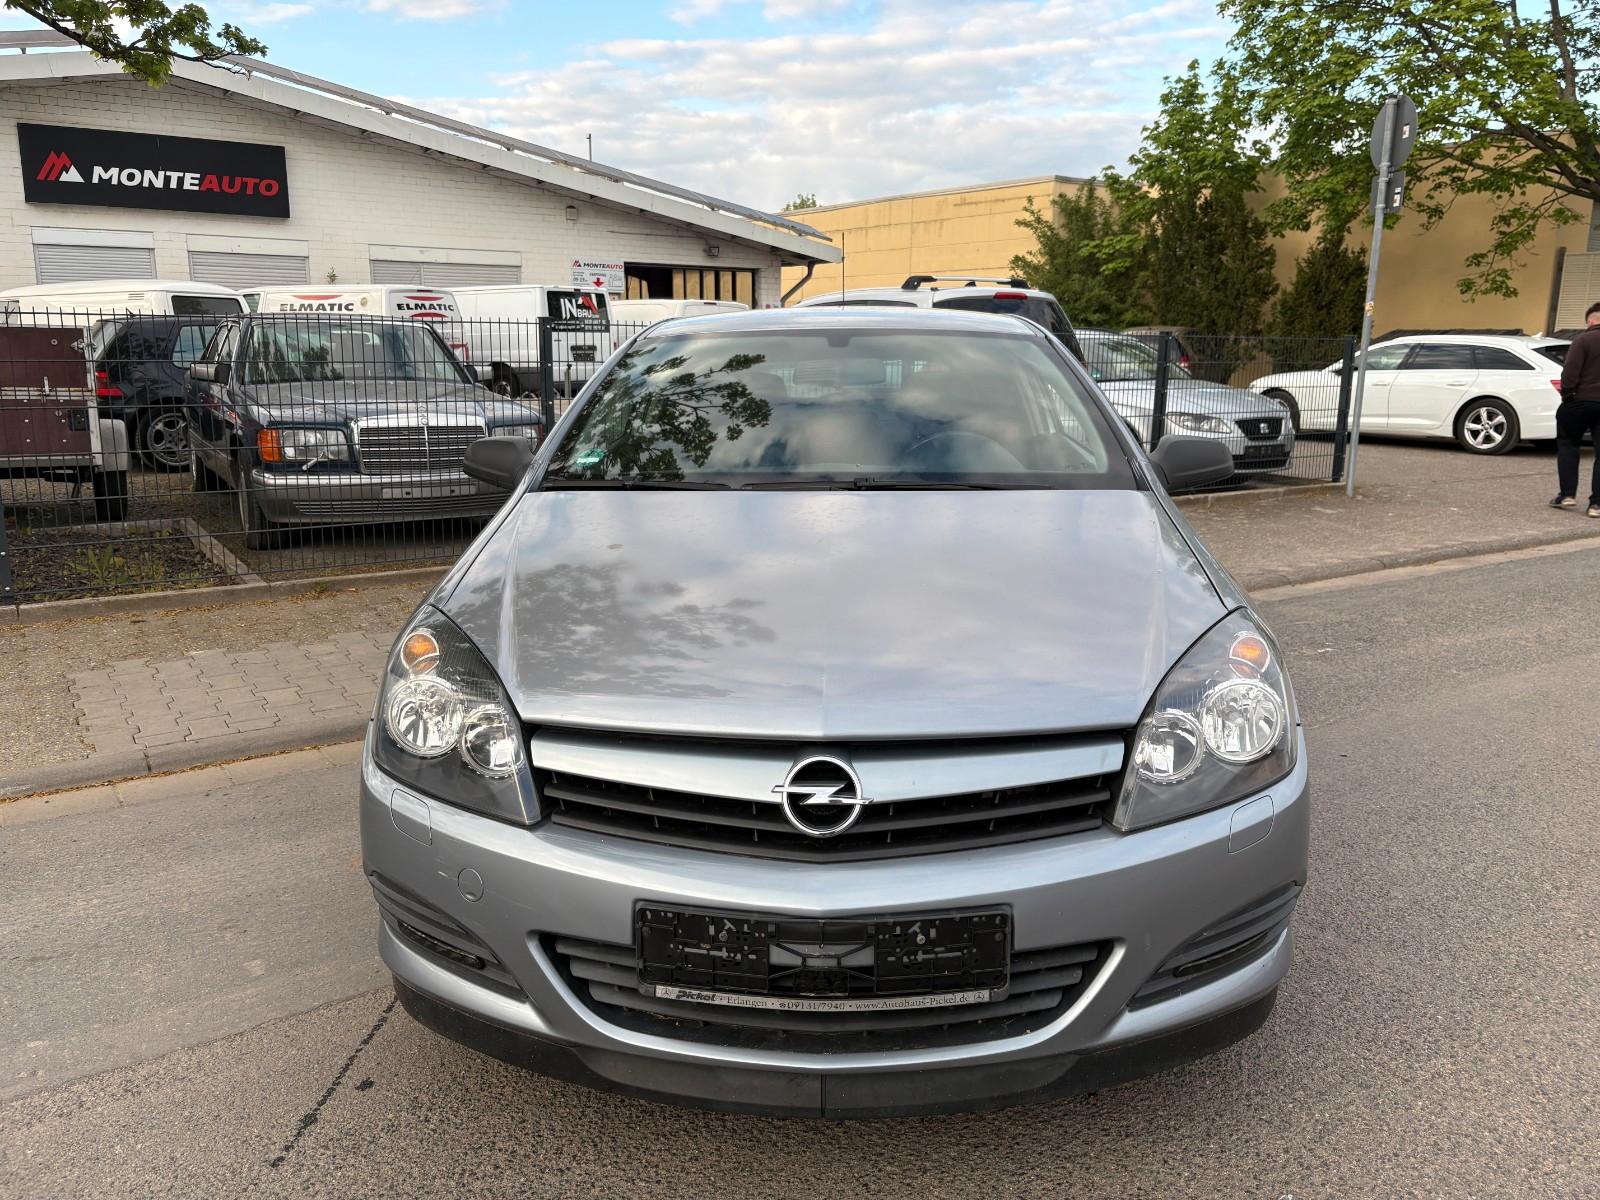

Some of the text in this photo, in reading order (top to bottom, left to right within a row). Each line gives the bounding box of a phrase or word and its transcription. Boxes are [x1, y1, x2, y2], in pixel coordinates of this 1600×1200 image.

[91, 165, 280, 197] MONTEAUTO
[582, 262, 624, 270] MONTEAUTO
[279, 302, 354, 312] ELMATIC
[396, 302, 455, 312] ELMATIC
[727, 996, 768, 1008] Erlangen
[855, 993, 969, 1010] www.Autohaus-Pickel.de
